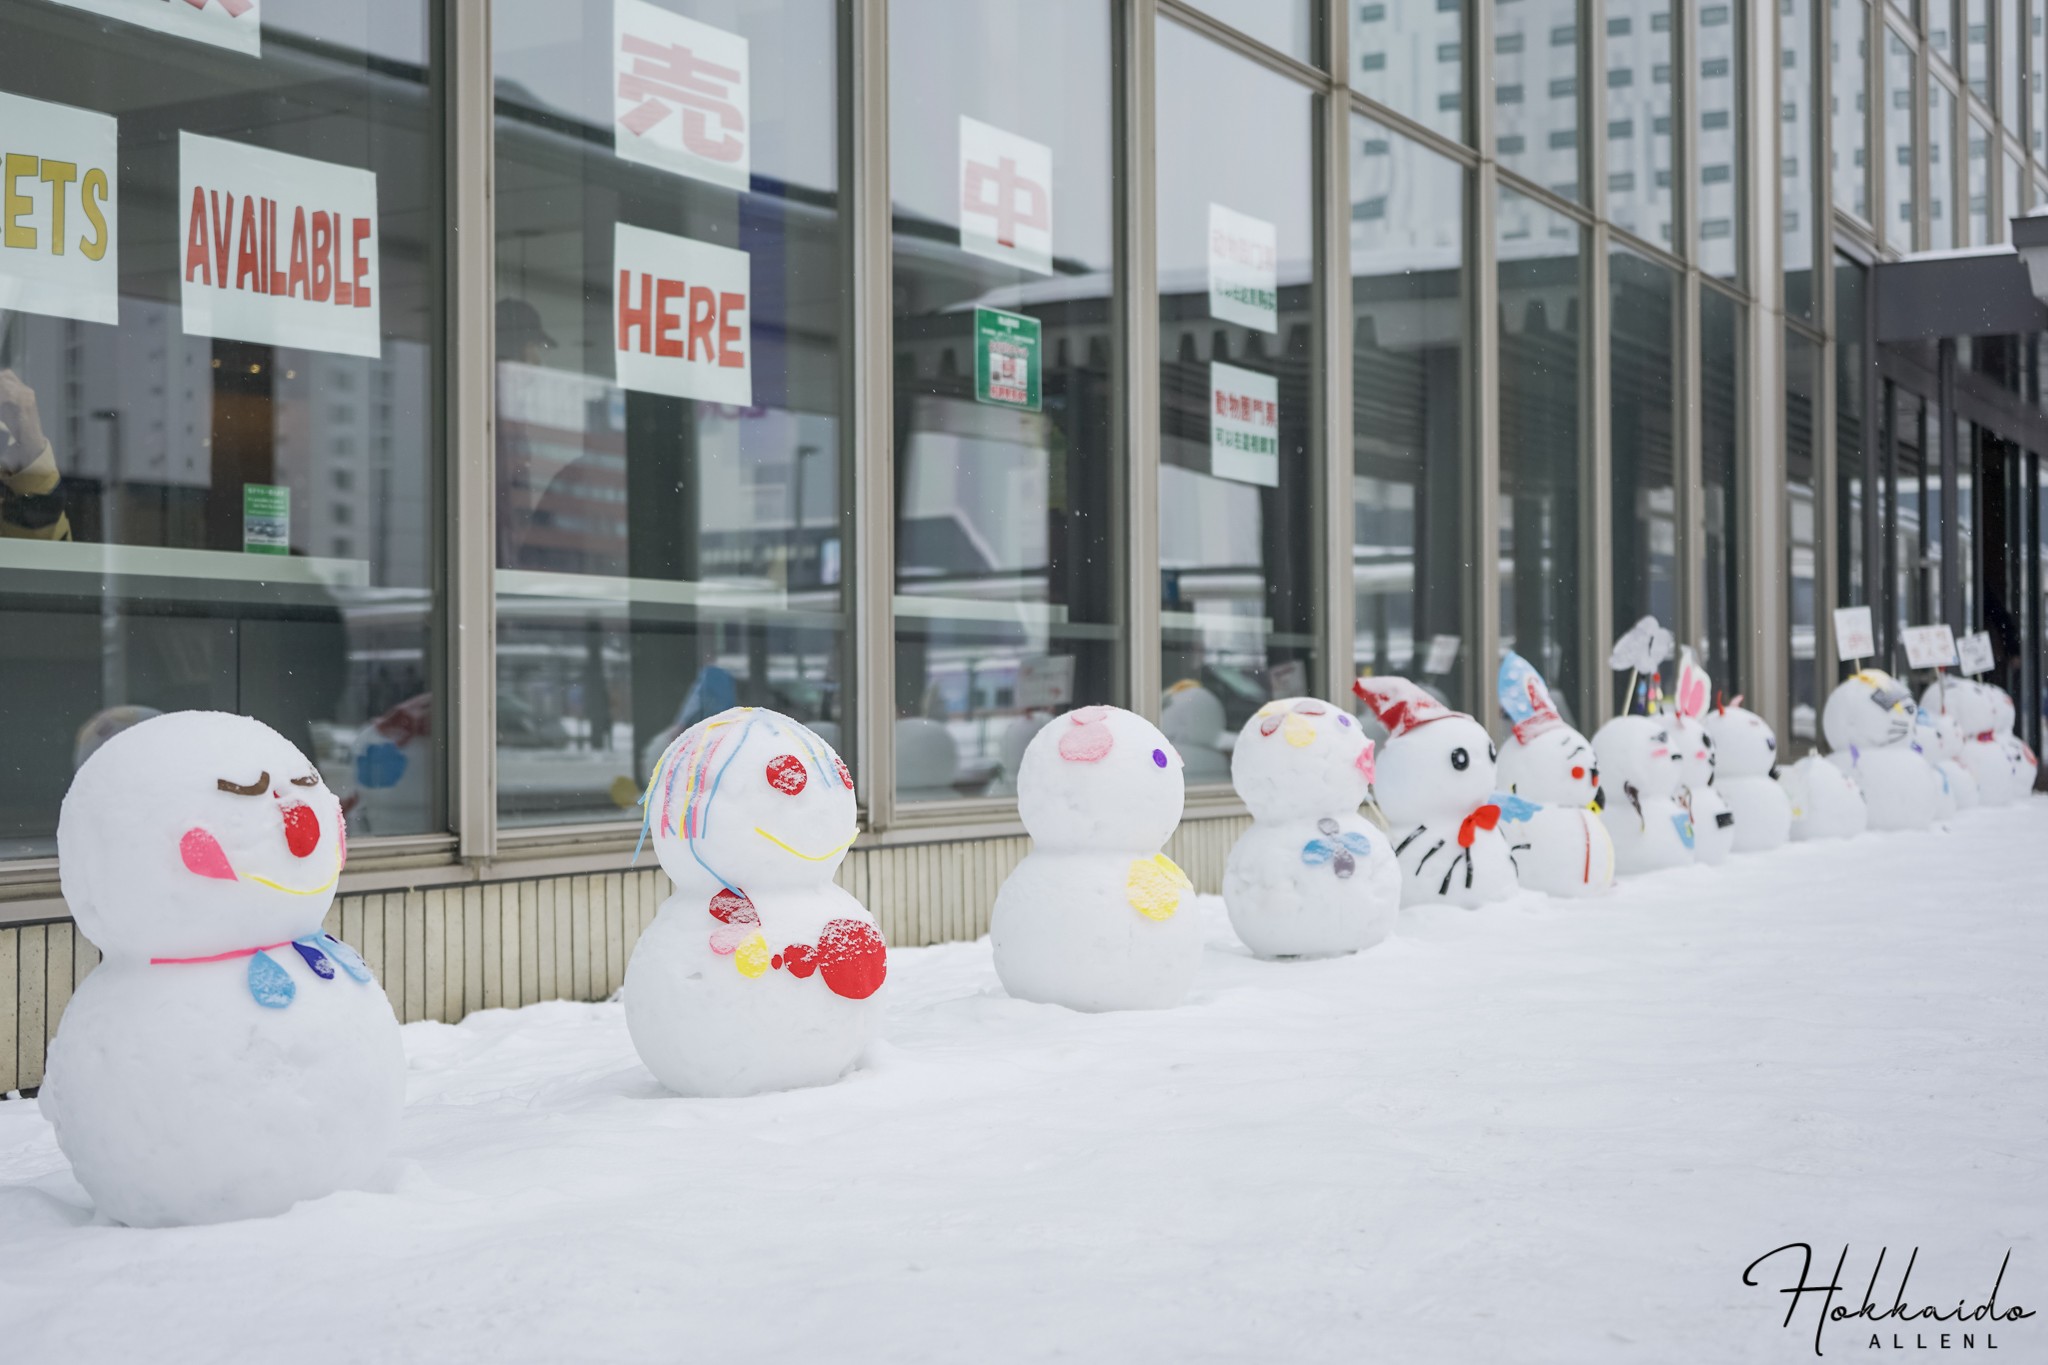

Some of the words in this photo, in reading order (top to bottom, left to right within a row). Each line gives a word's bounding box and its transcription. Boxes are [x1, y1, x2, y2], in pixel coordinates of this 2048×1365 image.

[617, 32, 745, 163] 売
[0, 153, 109, 262] ETS
[185, 185, 371, 308] AVAILABLE
[963, 156, 1048, 248] 中
[618, 269, 746, 369] HERE
